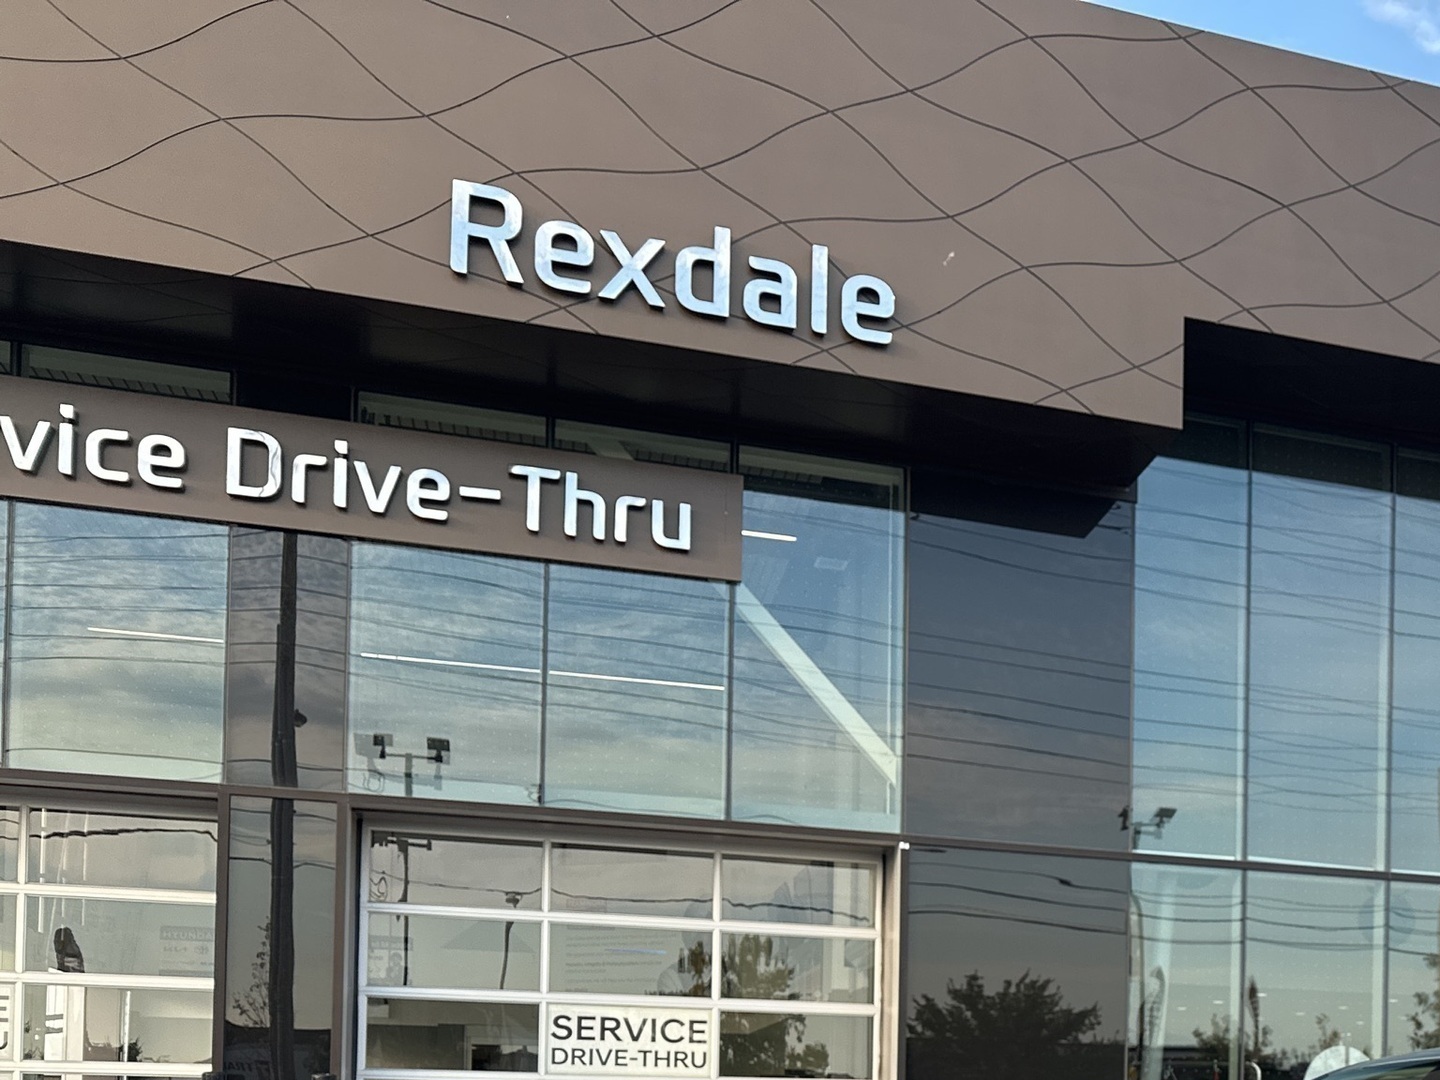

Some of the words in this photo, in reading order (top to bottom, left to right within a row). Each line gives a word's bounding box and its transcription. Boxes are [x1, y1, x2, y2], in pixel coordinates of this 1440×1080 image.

[448, 178, 896, 347] Rexdale
[0, 403, 187, 491] vice
[225, 424, 694, 553] Drive-Thru
[551, 1014, 708, 1044] SERVICE
[551, 1047, 707, 1069] DRIVE-THRU
